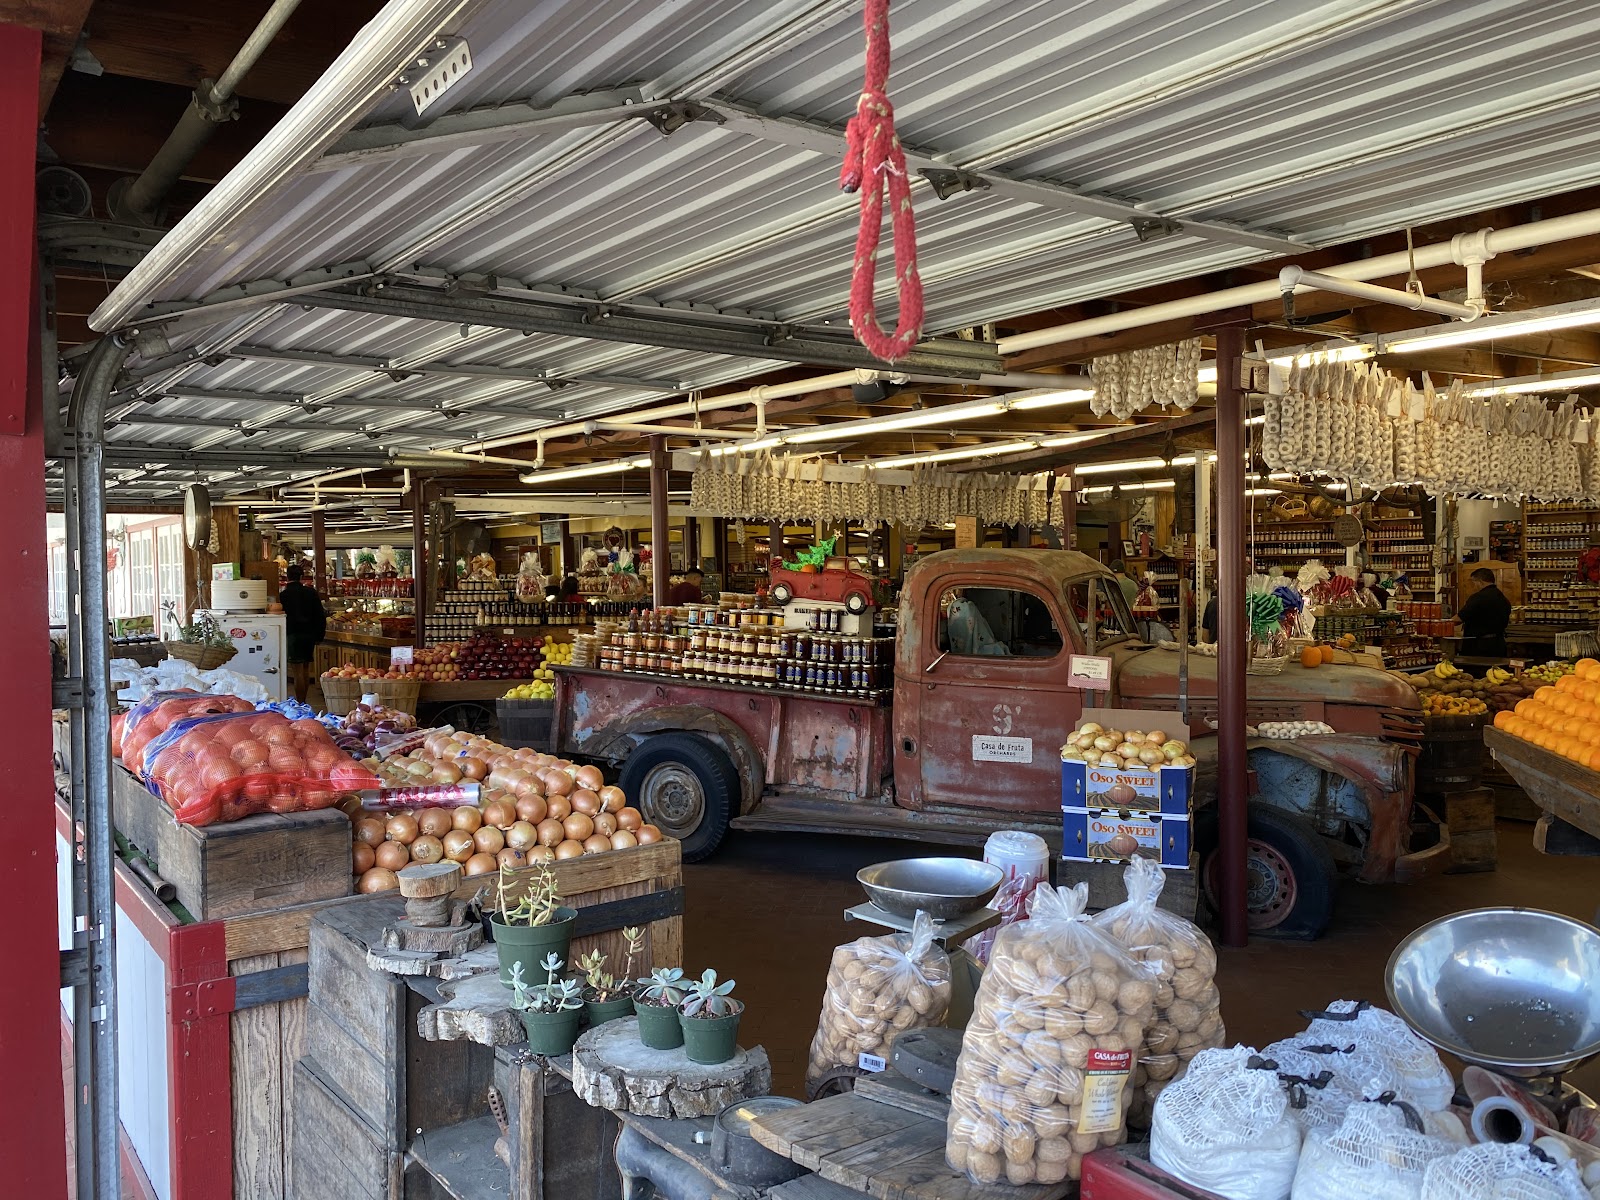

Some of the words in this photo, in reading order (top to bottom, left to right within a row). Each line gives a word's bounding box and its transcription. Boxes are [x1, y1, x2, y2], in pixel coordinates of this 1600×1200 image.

[981, 742, 996, 750] Casa
[997, 742, 1005, 750] de
[1007, 744, 1025, 752] Fruta
[1089, 771, 1114, 784] Oso
[1115, 774, 1156, 787] SWEET
[1091, 821, 1115, 834] Oso
[1116, 824, 1157, 837] SWEET
[1094, 1052, 1110, 1060] CASA
